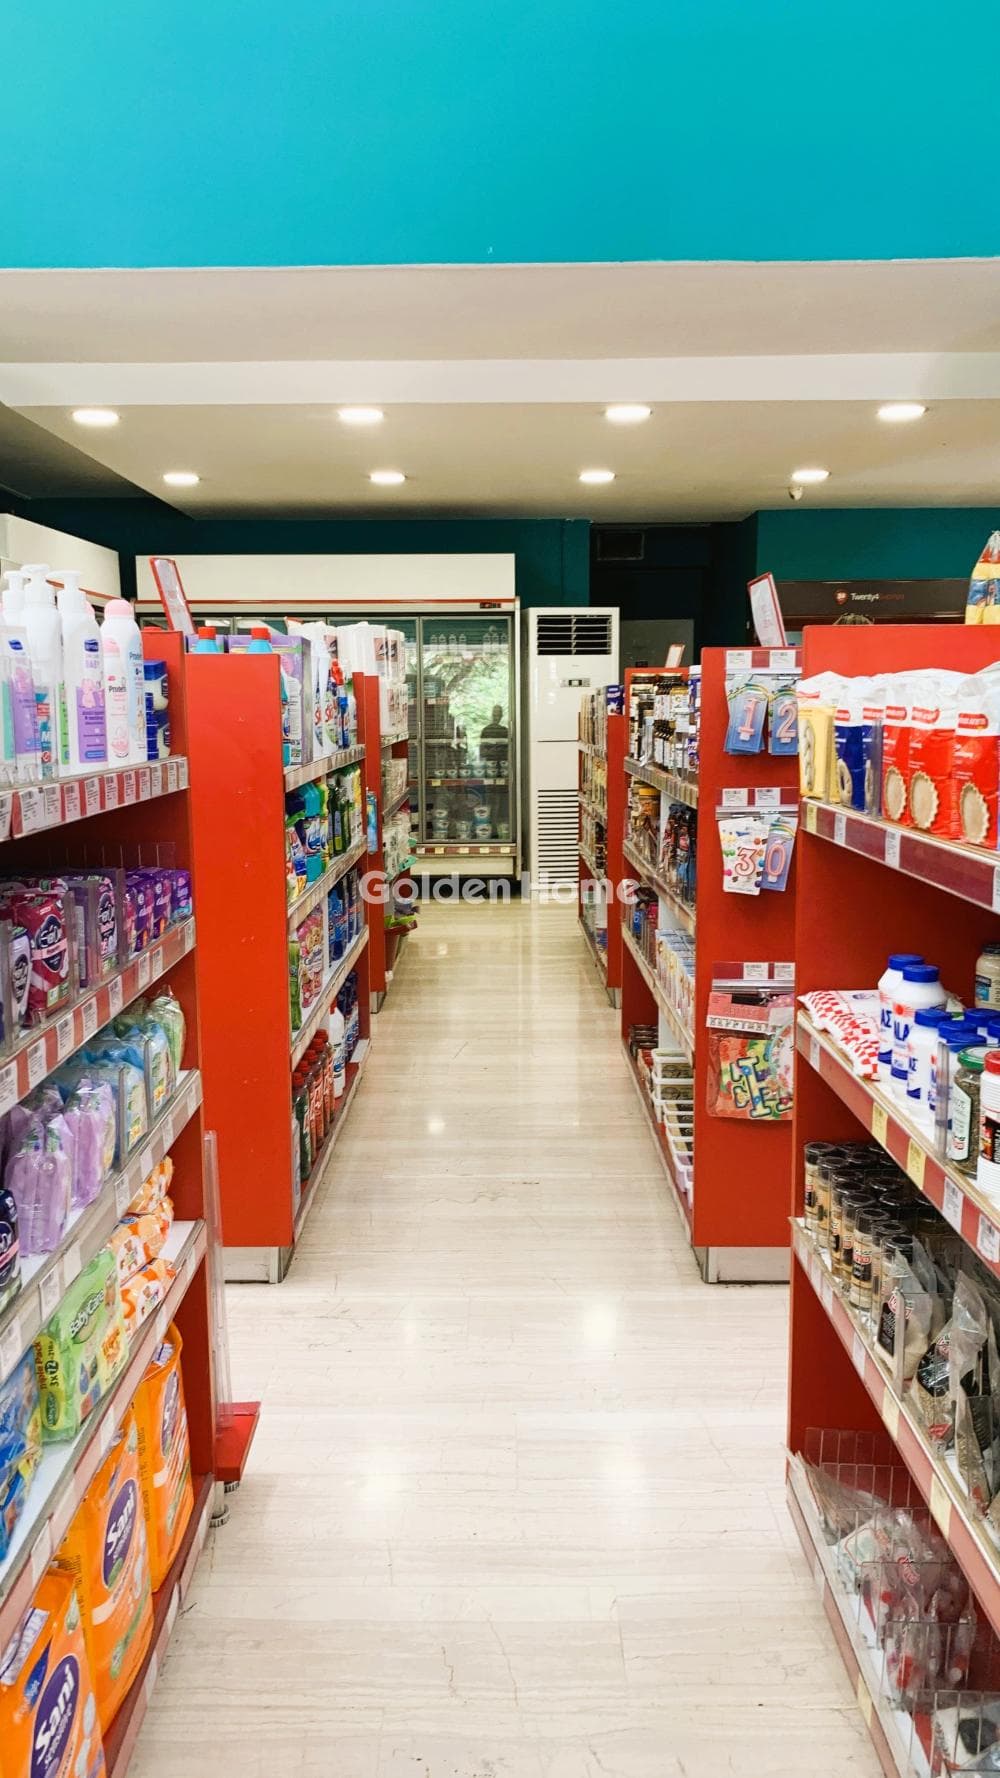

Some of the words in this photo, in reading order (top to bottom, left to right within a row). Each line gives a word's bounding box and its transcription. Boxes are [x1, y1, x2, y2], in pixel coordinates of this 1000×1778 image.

[738, 698, 758, 735] 1
[776, 702, 797, 738] 2
[735, 847, 758, 876] 3
[767, 842, 785, 877] 0
[107, 1486, 135, 1556] Sani
[35, 1663, 75, 1766] Sani
